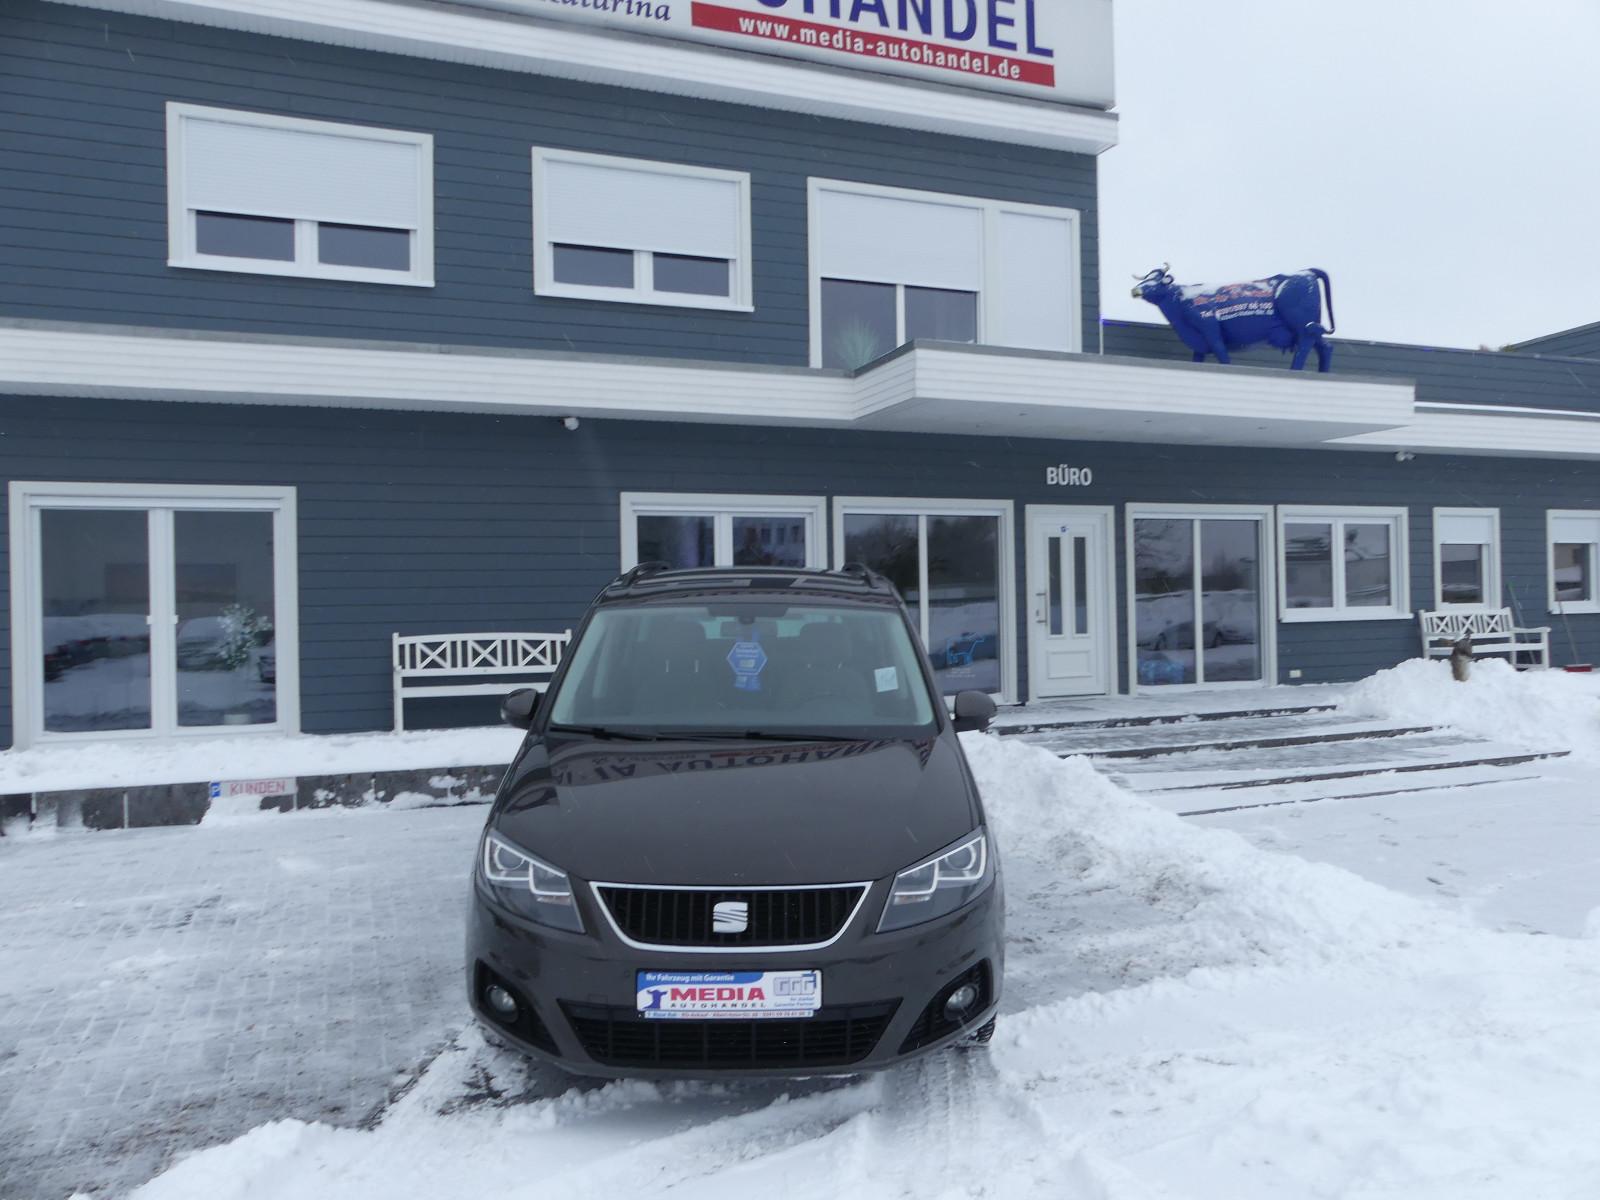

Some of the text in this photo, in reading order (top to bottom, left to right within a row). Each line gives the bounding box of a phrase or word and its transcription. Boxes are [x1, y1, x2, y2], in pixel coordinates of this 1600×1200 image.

[738, 16, 1022, 80] www.media-autohandel.de
[1046, 463, 1093, 486] BÜRO
[670, 987, 766, 1001] MEDIA
